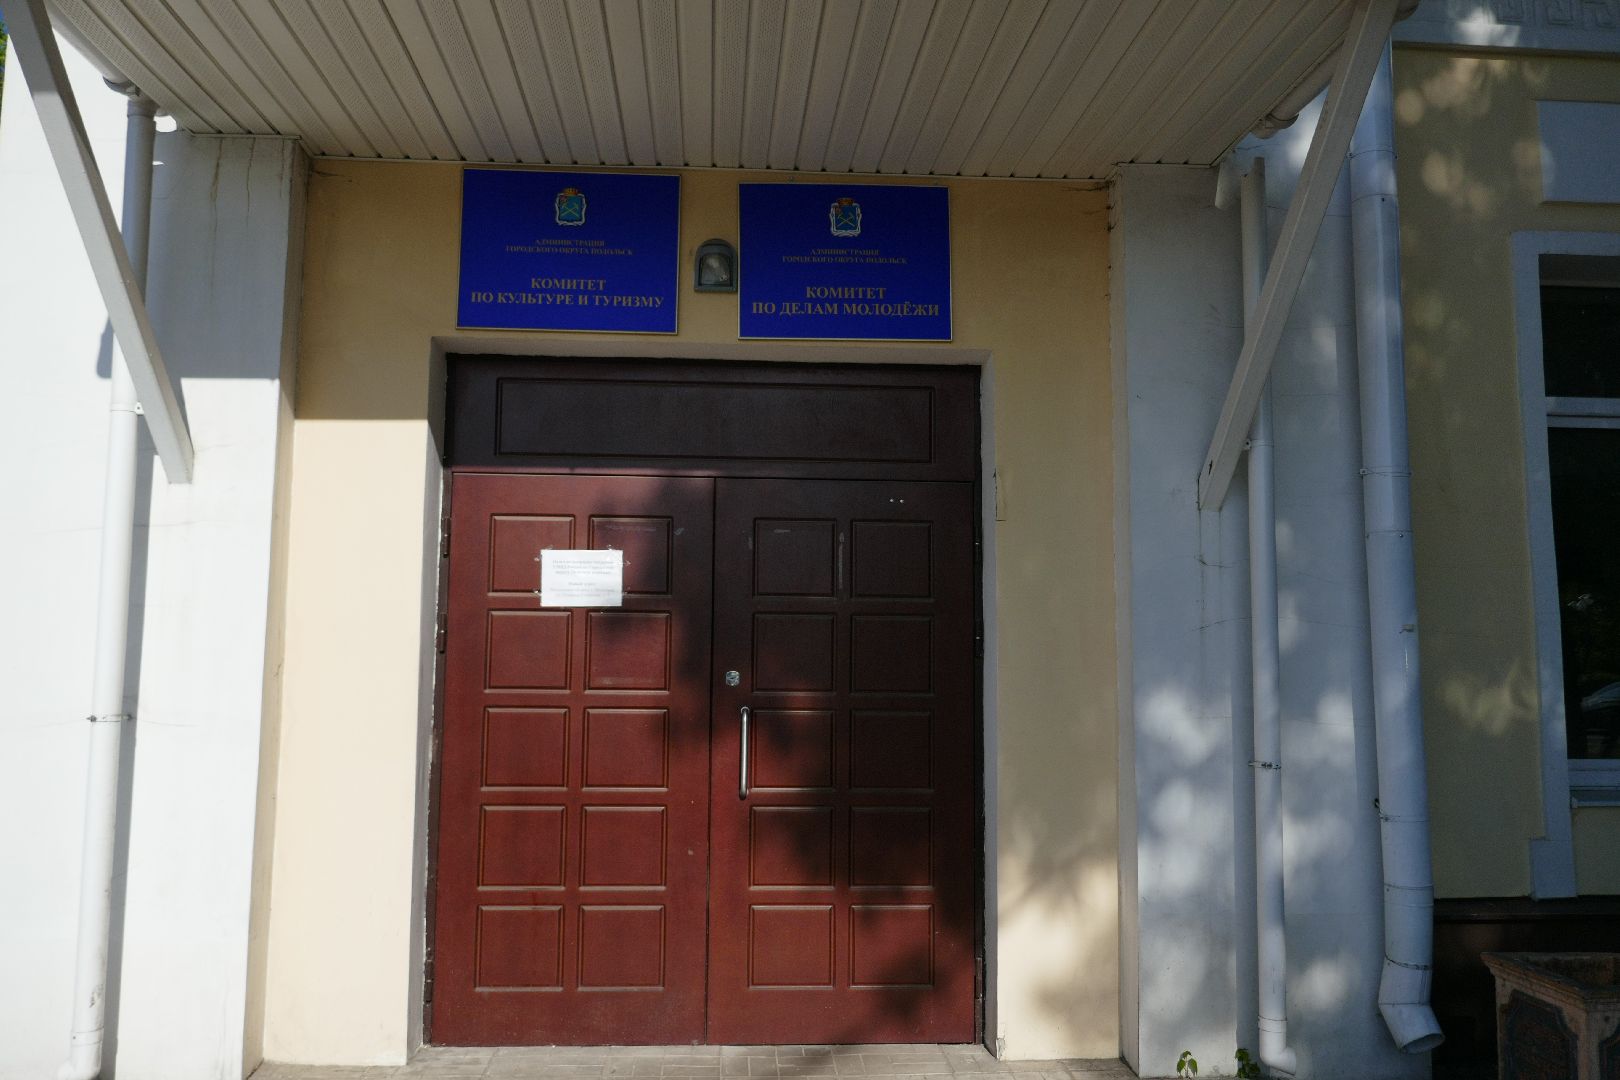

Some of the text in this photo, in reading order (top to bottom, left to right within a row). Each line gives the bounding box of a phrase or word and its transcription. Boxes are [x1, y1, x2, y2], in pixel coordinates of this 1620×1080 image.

[531, 278, 607, 290] КОМИТЕТ
[471, 291, 664, 308] ПО КУЛЬТУРЕ И ТУРИЗМУ
[806, 286, 887, 299] КОМИТЕТ
[752, 301, 940, 317] ПО ДЕЛАМ МОЛОДЁЖИ
